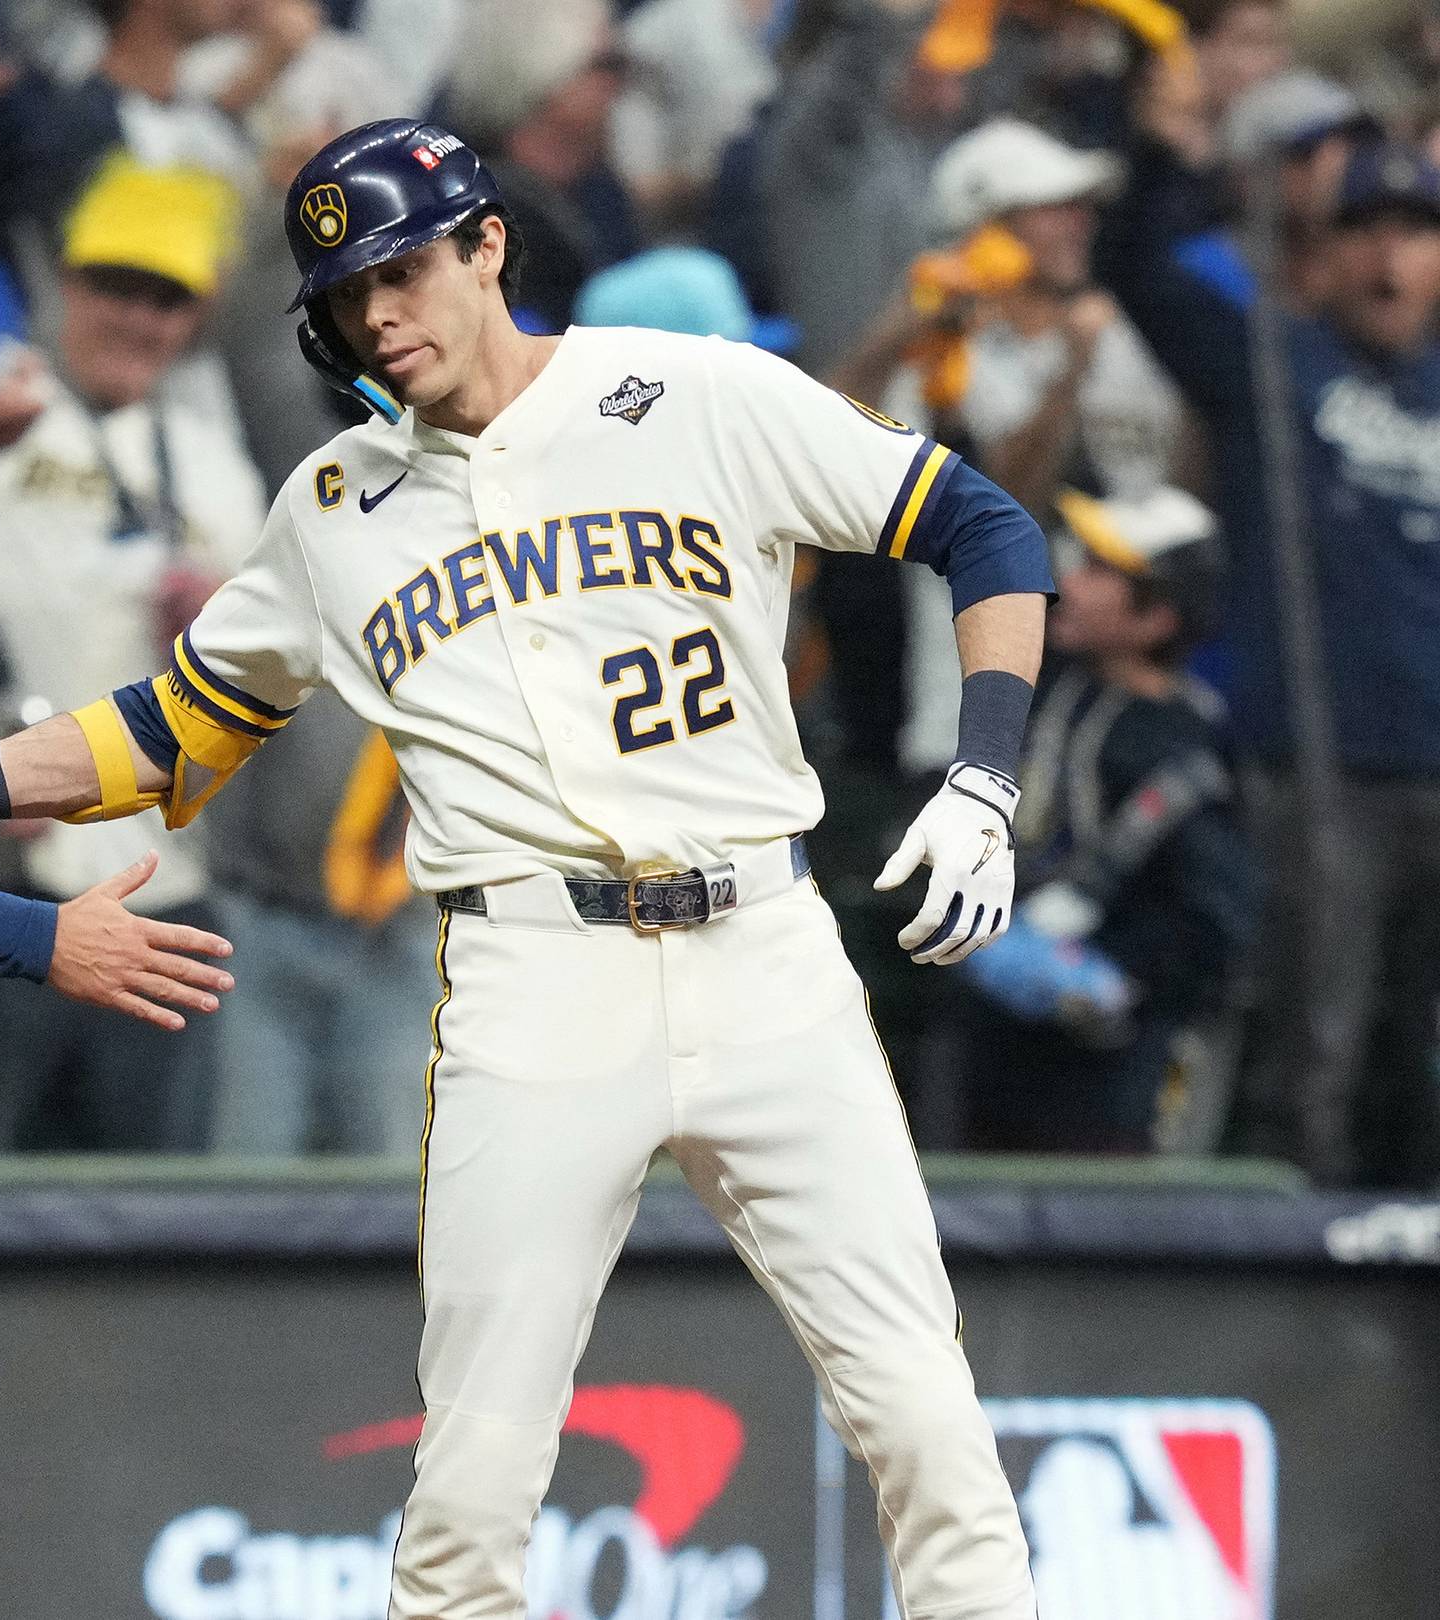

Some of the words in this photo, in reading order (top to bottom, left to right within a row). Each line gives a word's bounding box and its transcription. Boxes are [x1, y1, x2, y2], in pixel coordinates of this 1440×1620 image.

[601, 390, 637, 415] World
[630, 383, 662, 409] Series
[313, 460, 345, 512] C
[361, 507, 733, 698] BREWERS
[598, 624, 737, 757] 22
[710, 878, 734, 908] 22
